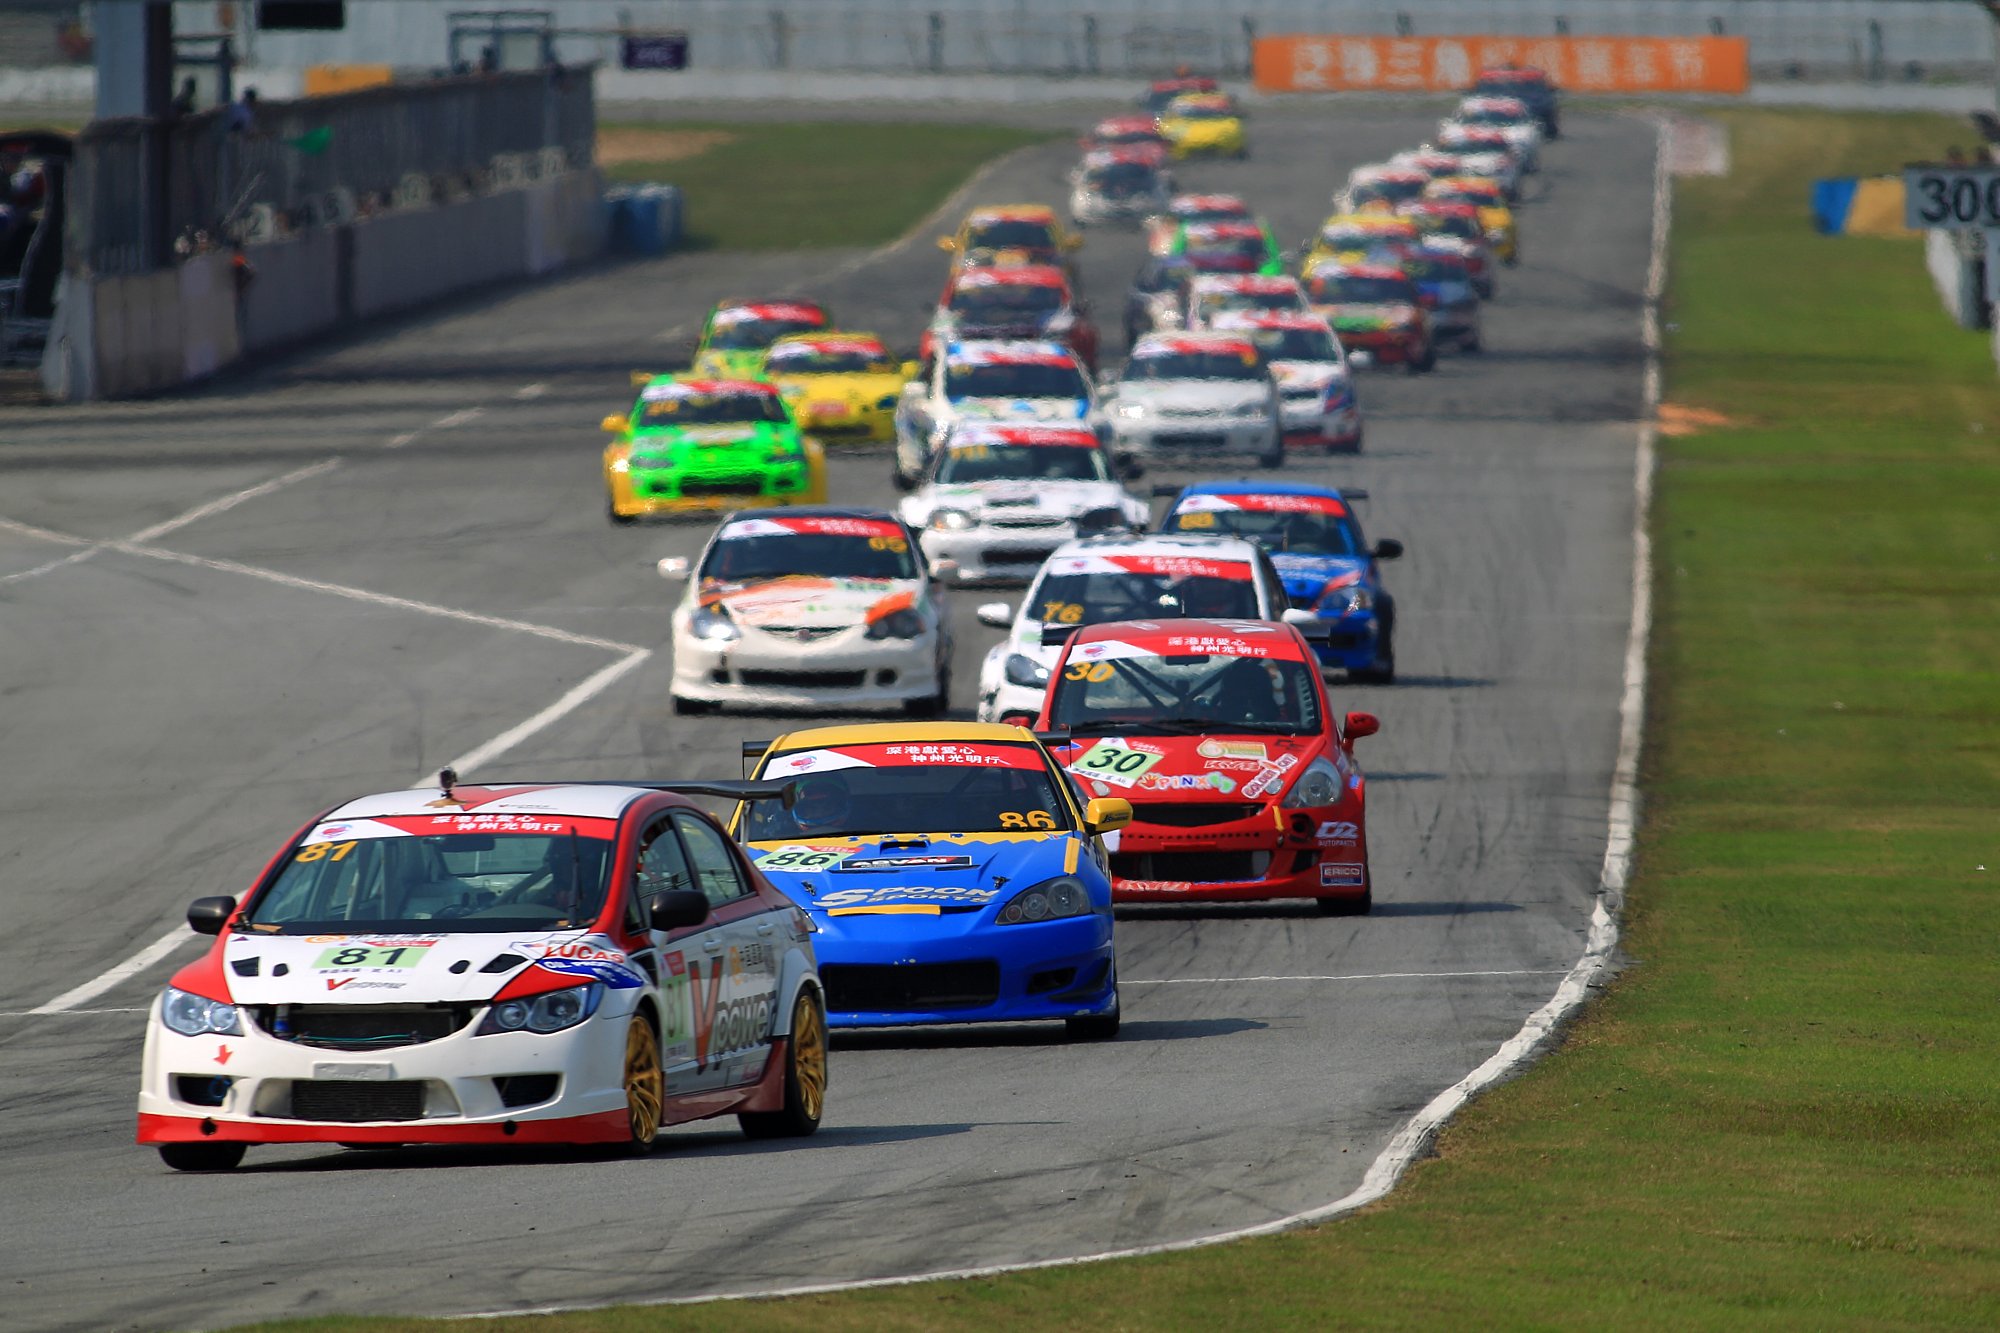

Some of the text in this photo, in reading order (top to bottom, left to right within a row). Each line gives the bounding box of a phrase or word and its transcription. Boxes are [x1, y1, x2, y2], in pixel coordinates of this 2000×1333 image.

[1065, 662, 1115, 682] 30
[910, 754, 1000, 764] 神州光明行
[1087, 748, 1147, 773] 30
[456, 822, 563, 832] 神州光明行
[999, 810, 1056, 829] 86
[1314, 821, 1358, 839] D2
[294, 840, 358, 862] 81
[766, 852, 838, 866] 86
[1324, 867, 1360, 876] ERICO
[812, 886, 1000, 907] SPOON
[332, 947, 409, 965] 81
[543, 945, 625, 963] LUCAS
